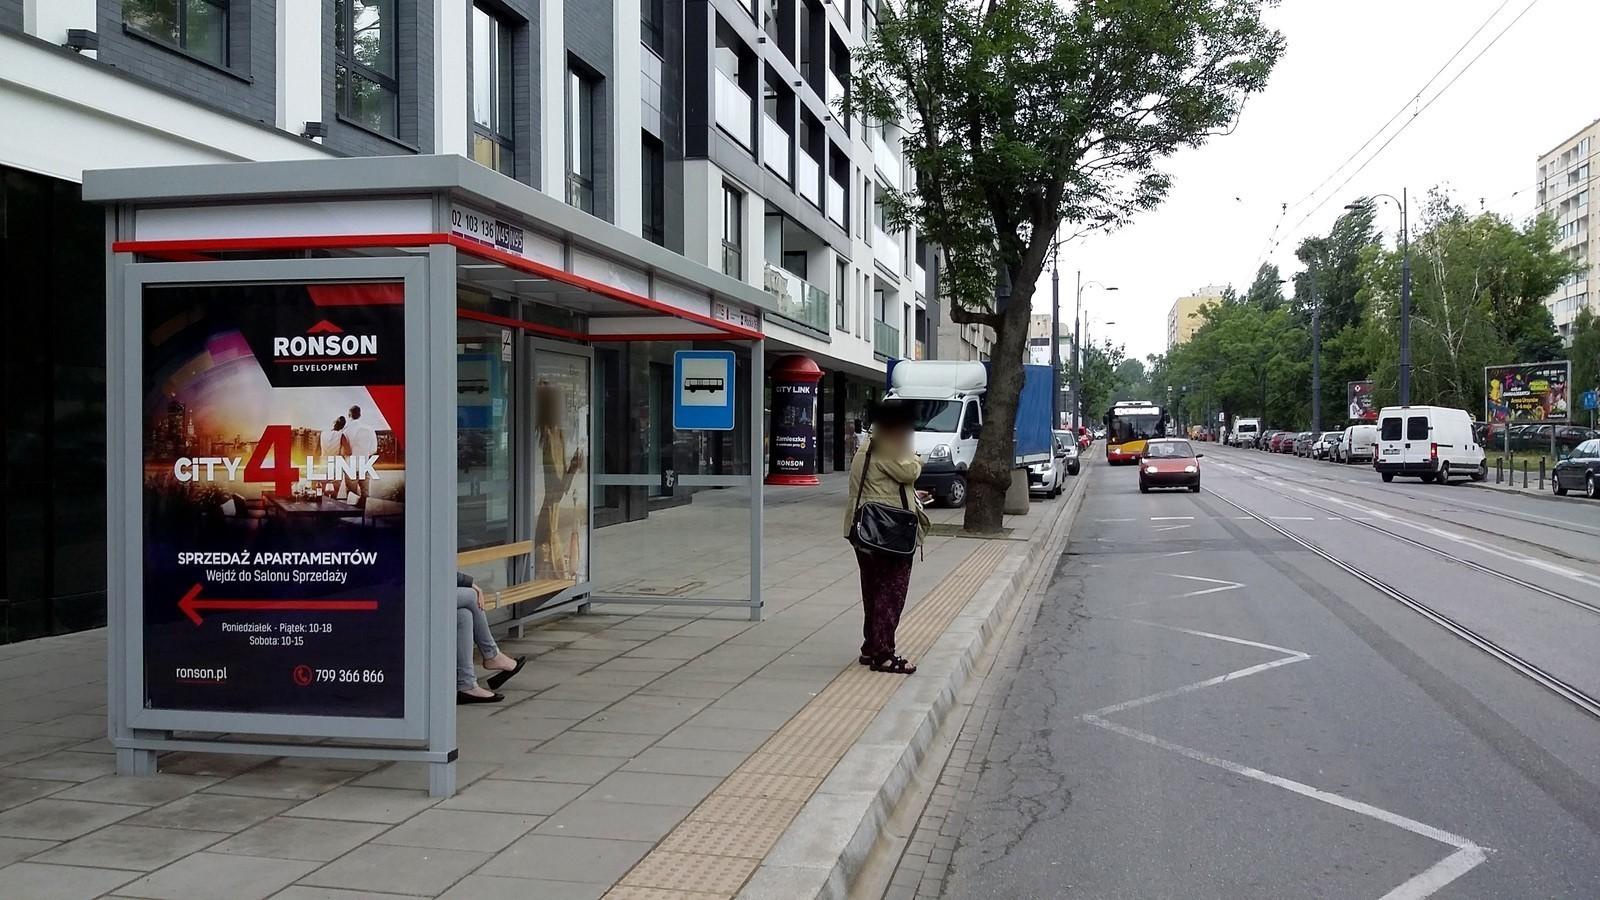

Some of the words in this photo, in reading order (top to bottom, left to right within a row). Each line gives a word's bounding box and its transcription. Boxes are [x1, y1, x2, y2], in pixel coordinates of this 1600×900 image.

[466, 215, 478, 232] 103
[482, 220, 493, 238] 136
[496, 225, 508, 243] N45
[274, 335, 377, 356] RONSON
[292, 363, 359, 372] DEVELOPMENT
[793, 386, 810, 394] LINK
[244, 425, 300, 497] 4
[178, 550, 250, 565] SPRZEDAŻ
[254, 549, 377, 565] APARTAMENTÓW
[206, 569, 236, 583] Wejdź
[239, 570, 251, 582] do
[254, 570, 290, 582] Salonu
[292, 569, 347, 584] Sprzedaży
[222, 623, 272, 632] Poniedziałek
[279, 623, 308, 634] Piątek:
[309, 623, 332, 633] 10-18
[249, 636, 280, 646] Sobota:
[281, 636, 304, 646] 10-15
[176, 667, 227, 681] ronson.pl
[315, 669, 336, 683] 799
[339, 670, 360, 683] 366
[363, 670, 384, 683] 866
